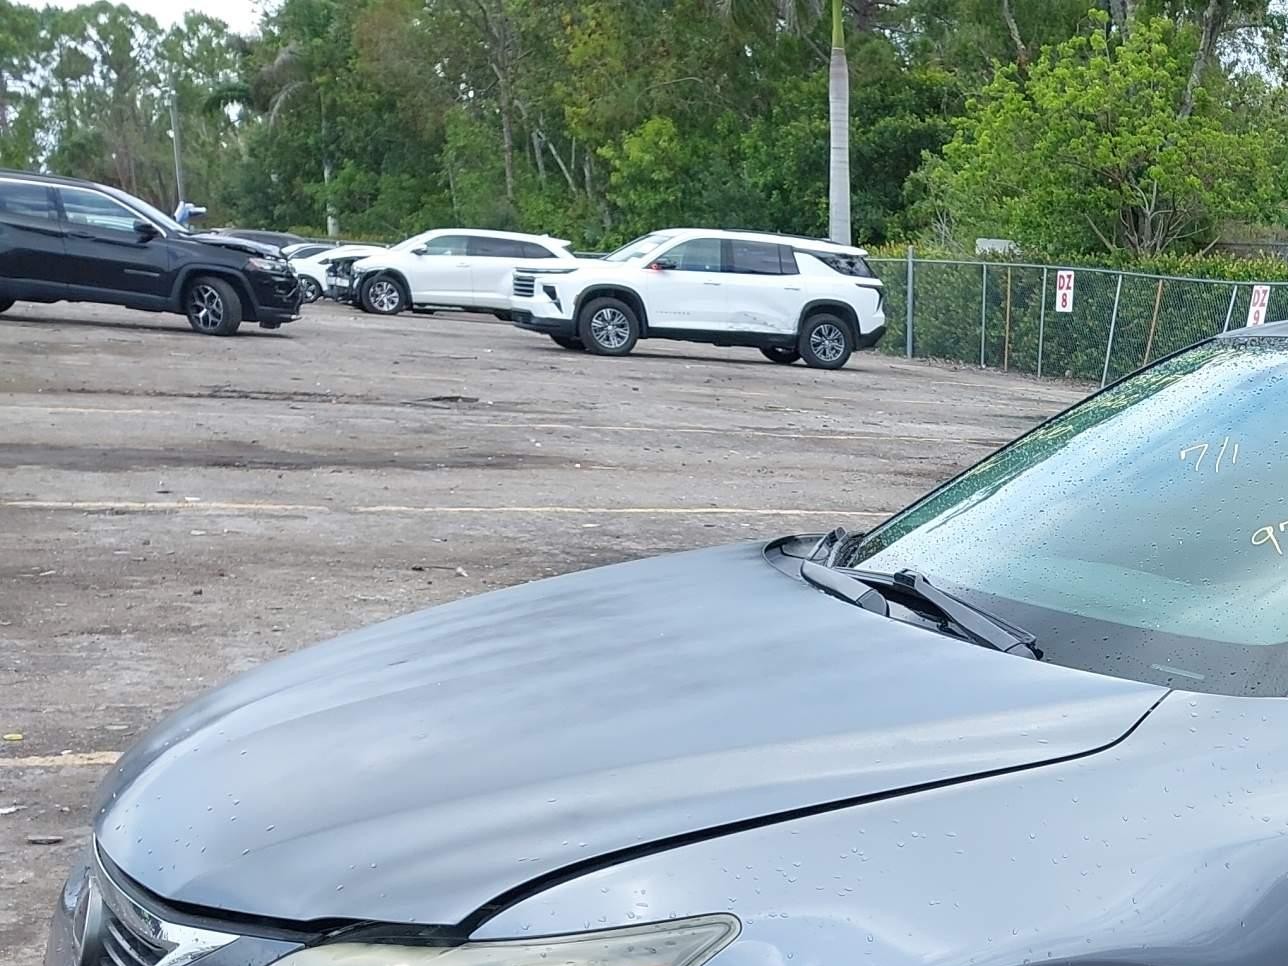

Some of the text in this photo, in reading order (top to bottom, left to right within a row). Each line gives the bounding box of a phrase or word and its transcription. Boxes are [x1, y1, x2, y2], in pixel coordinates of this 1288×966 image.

[1058, 274, 1073, 290] DZ
[1061, 292, 1068, 309] 8
[1252, 289, 1269, 307] DZ
[1252, 310, 1260, 326] 9
